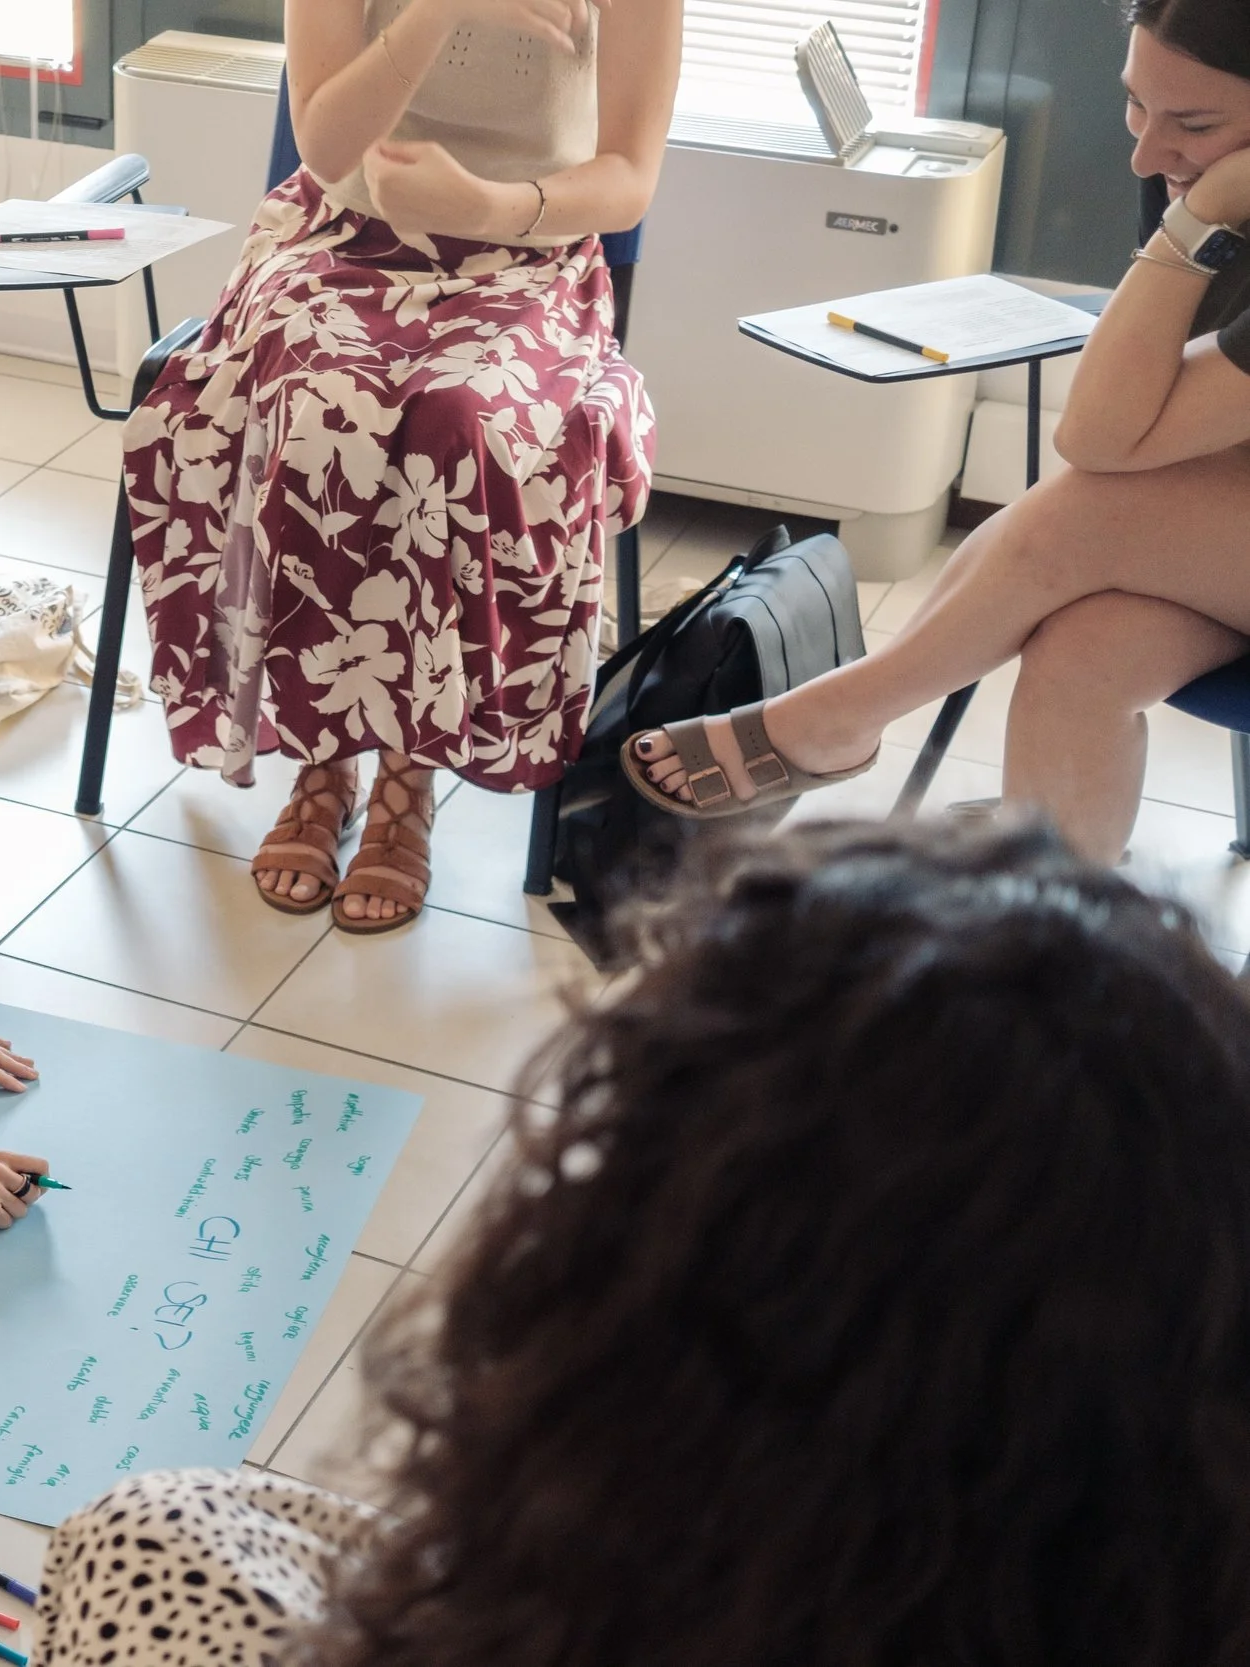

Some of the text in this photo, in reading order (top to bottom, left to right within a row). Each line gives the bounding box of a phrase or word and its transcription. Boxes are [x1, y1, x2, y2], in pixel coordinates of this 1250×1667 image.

[188, 1215, 241, 1262] CHI
[87, 1395, 113, 1424] dubbi
[5, 1443, 44, 1486] famiglia
